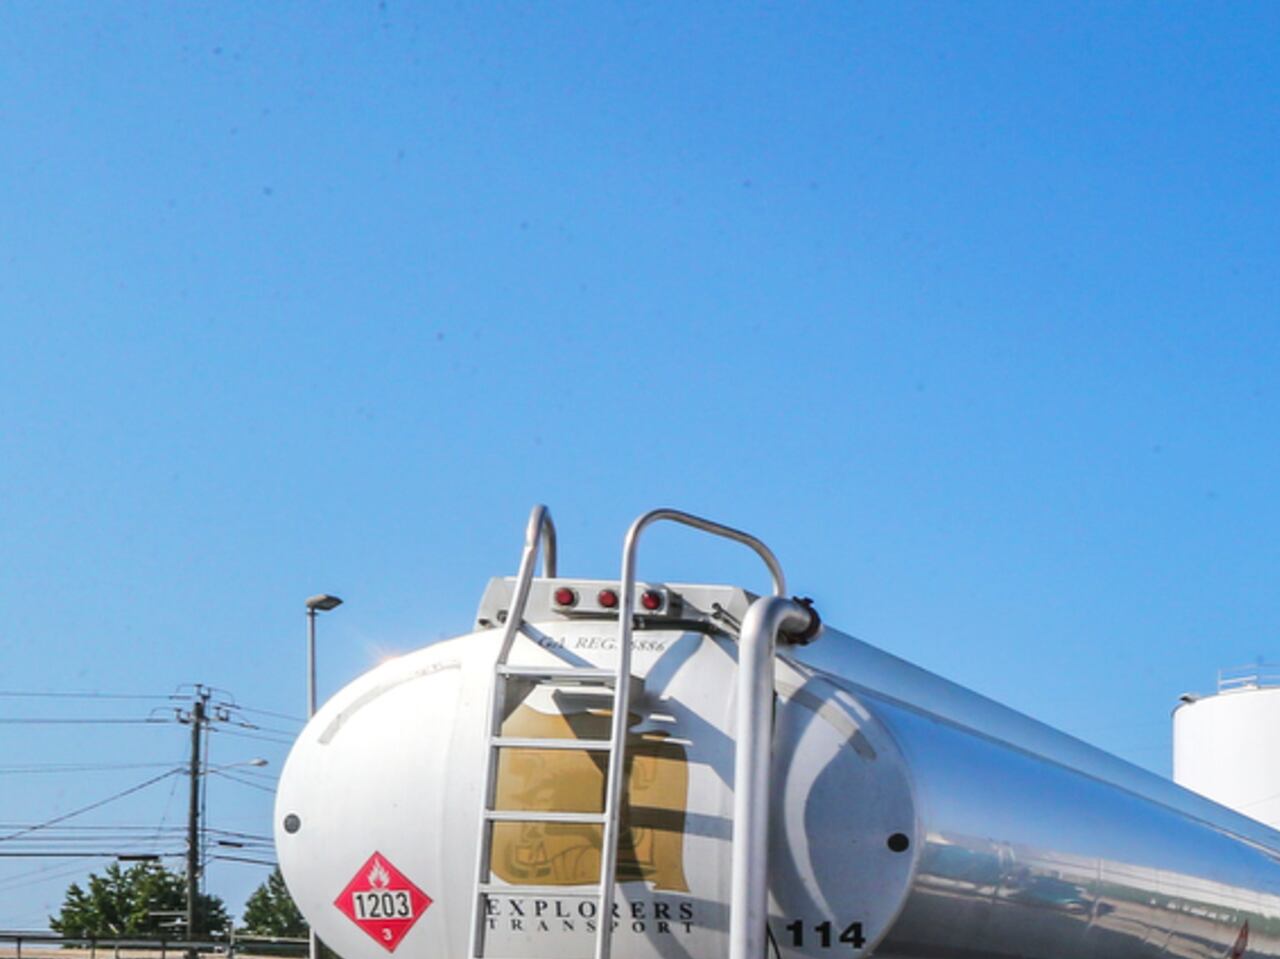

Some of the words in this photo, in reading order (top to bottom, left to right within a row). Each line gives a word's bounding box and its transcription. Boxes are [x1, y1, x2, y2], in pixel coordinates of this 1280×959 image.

[356, 892, 409, 917] 1203
[485, 898, 694, 920] EXPLORERS
[382, 928, 393, 941] 3
[786, 920, 866, 949] 114
